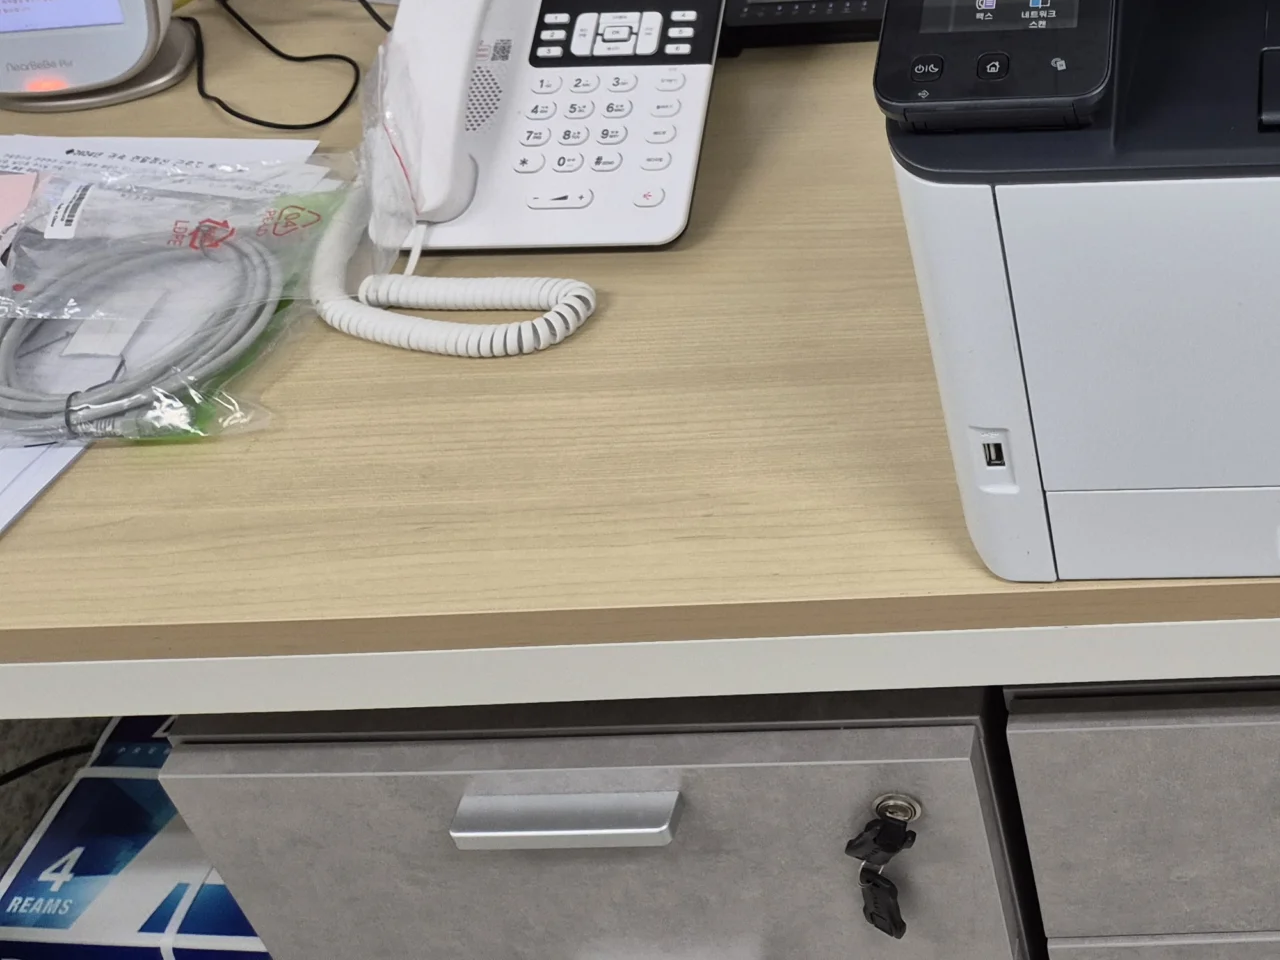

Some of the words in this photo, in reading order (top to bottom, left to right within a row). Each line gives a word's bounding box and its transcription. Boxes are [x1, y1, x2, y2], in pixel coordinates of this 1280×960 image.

[975, 12, 993, 20] 팩스
[1021, 10, 1057, 19] 네트워크
[1028, 20, 1047, 29] 스캔
[539, 79, 545, 89] 1
[573, 78, 582, 88] 2
[612, 77, 621, 87] 3
[531, 104, 539, 114] 4
[568, 103, 577, 114] 5
[606, 102, 615, 113] 6
[526, 130, 534, 141] 7
[562, 130, 571, 140] 8
[600, 129, 609, 139] 9
[557, 156, 566, 167] 0
[167, 220, 190, 247] LDPE
[37, 846, 86, 892] 4
[5, 895, 73, 915] REAMS
